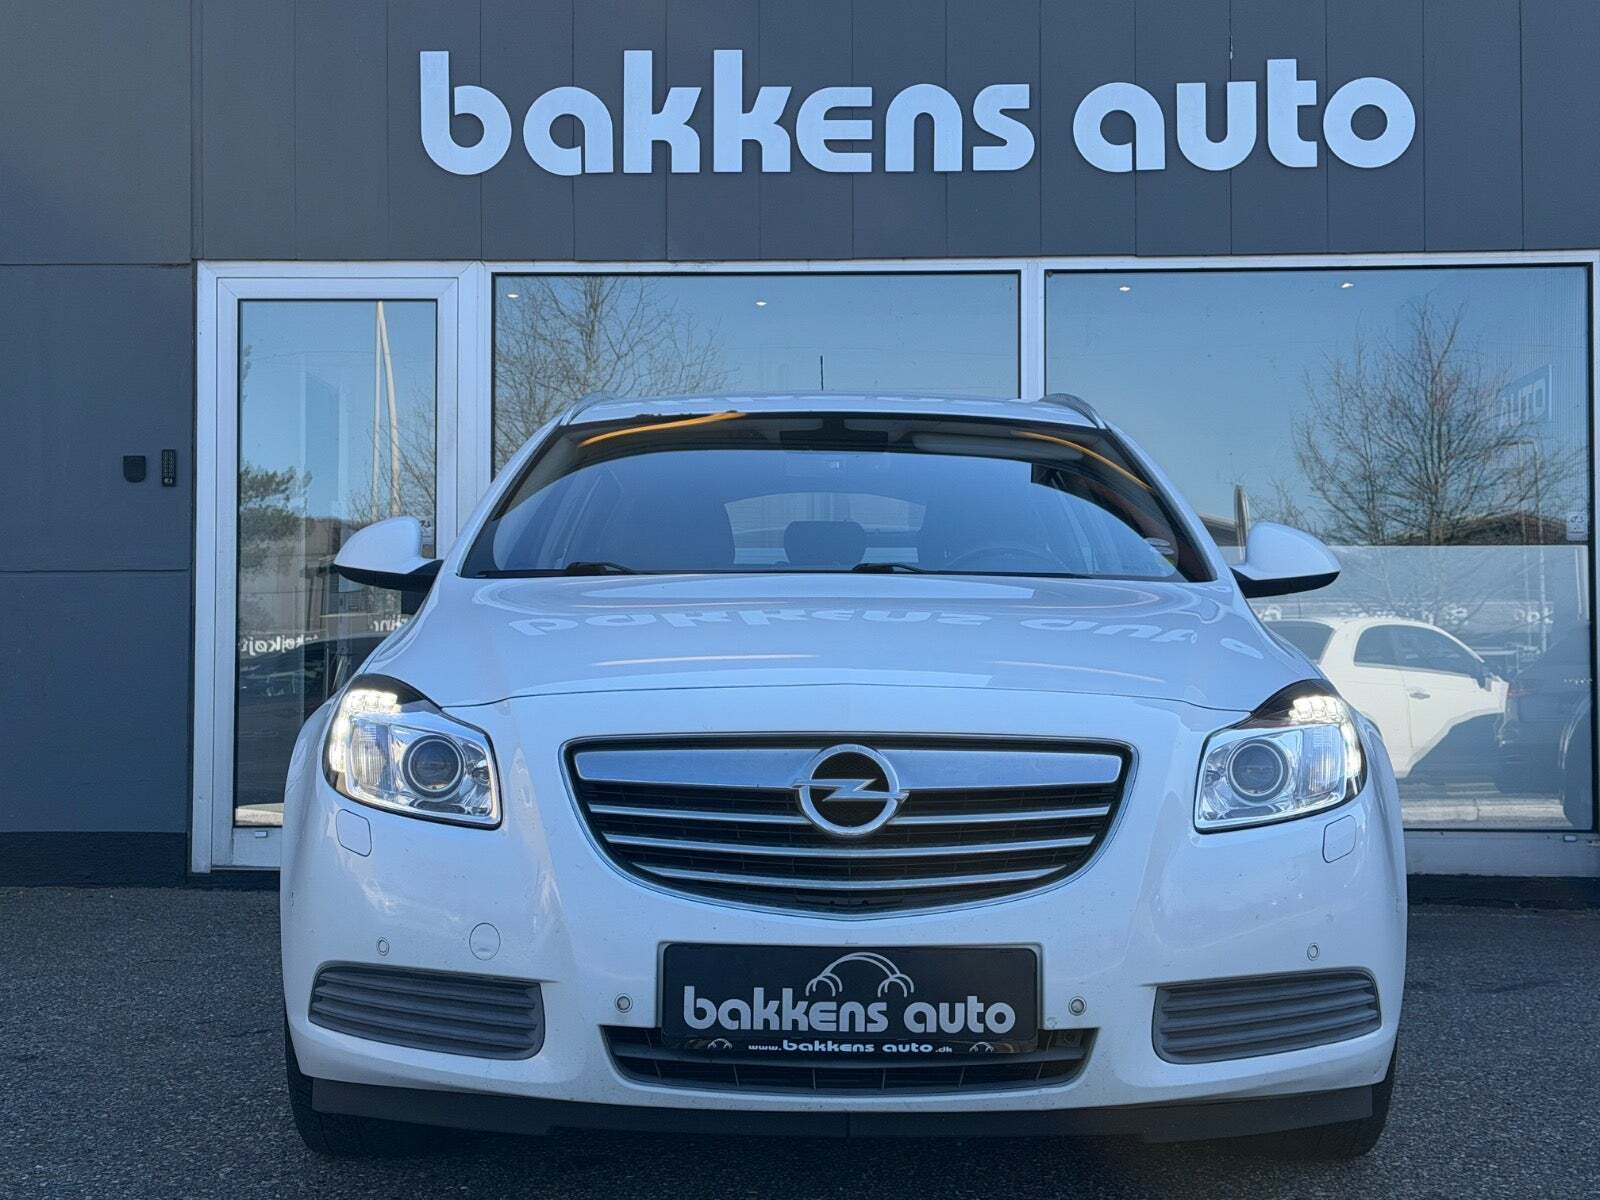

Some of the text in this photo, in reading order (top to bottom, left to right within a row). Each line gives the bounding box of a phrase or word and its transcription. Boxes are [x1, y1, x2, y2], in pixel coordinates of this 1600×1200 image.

[420, 50, 1416, 176] bakkens auto
[683, 985, 1017, 1035] bakkens auto
